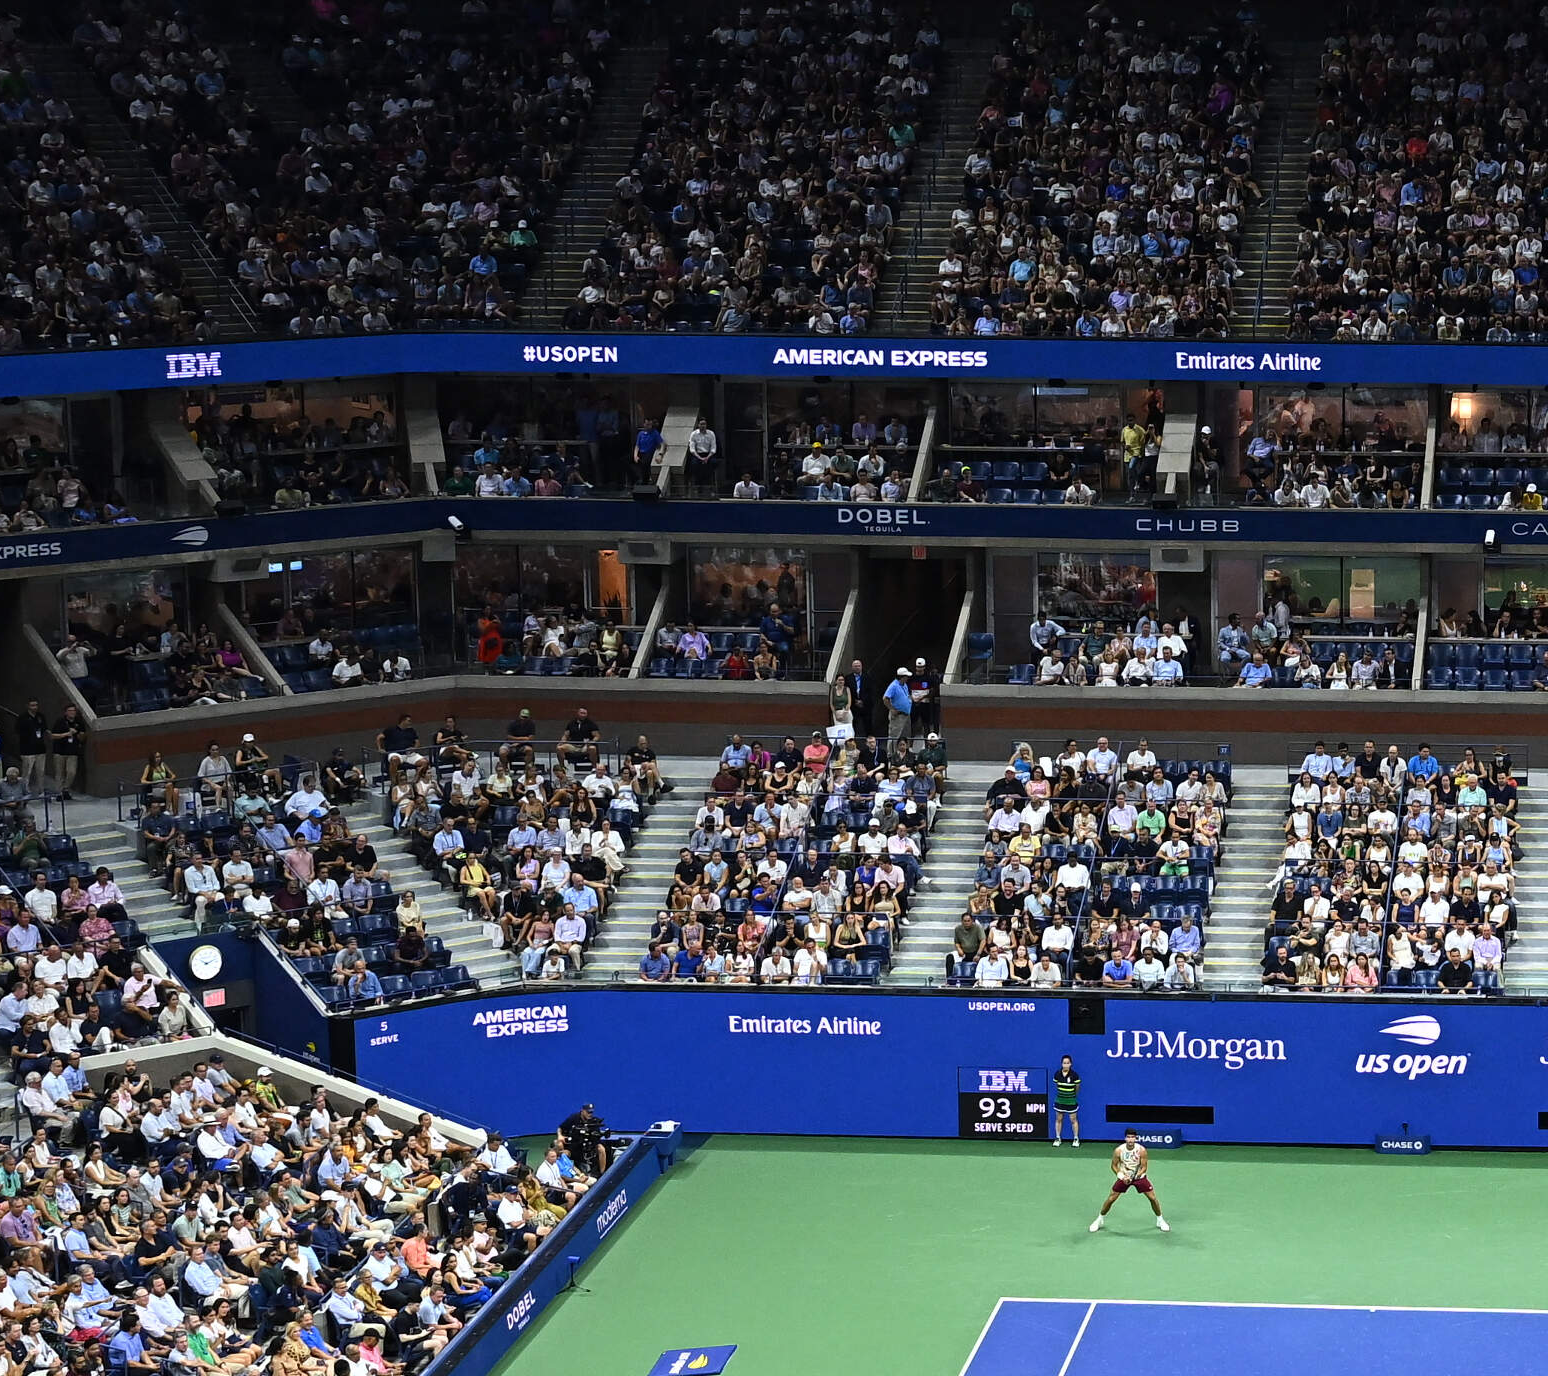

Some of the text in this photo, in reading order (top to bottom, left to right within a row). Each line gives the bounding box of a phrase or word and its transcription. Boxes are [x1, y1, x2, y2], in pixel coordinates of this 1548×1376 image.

[523, 345, 618, 363] #USOPEN
[772, 348, 988, 367] AMERICAN EXPRESS
[1175, 351, 1322, 371] Emirates Airline
[165, 351, 222, 379] IBM
[864, 526, 903, 534] TEQUILA
[1136, 518, 1240, 533] CHUBB
[472, 1004, 568, 1026] AMERICAN
[968, 1001, 1036, 1012] USOPEN.ORG
[380, 1021, 388, 1032] 5
[485, 1018, 569, 1038] EXPRESS
[728, 1015, 882, 1036] Emirates Airline
[370, 1033, 399, 1047] SERVE
[1106, 1029, 1287, 1070] J.P.Morgan
[1355, 1054, 1468, 1081] us open
[978, 1070, 1029, 1092] IBM
[978, 1097, 1046, 1119] 93 MPH
[974, 1122, 1034, 1133] SERVE SPEED
[1381, 1140, 1413, 1149] CHASE
[596, 1188, 627, 1230] moderna
[506, 1290, 536, 1330] DOBEL
